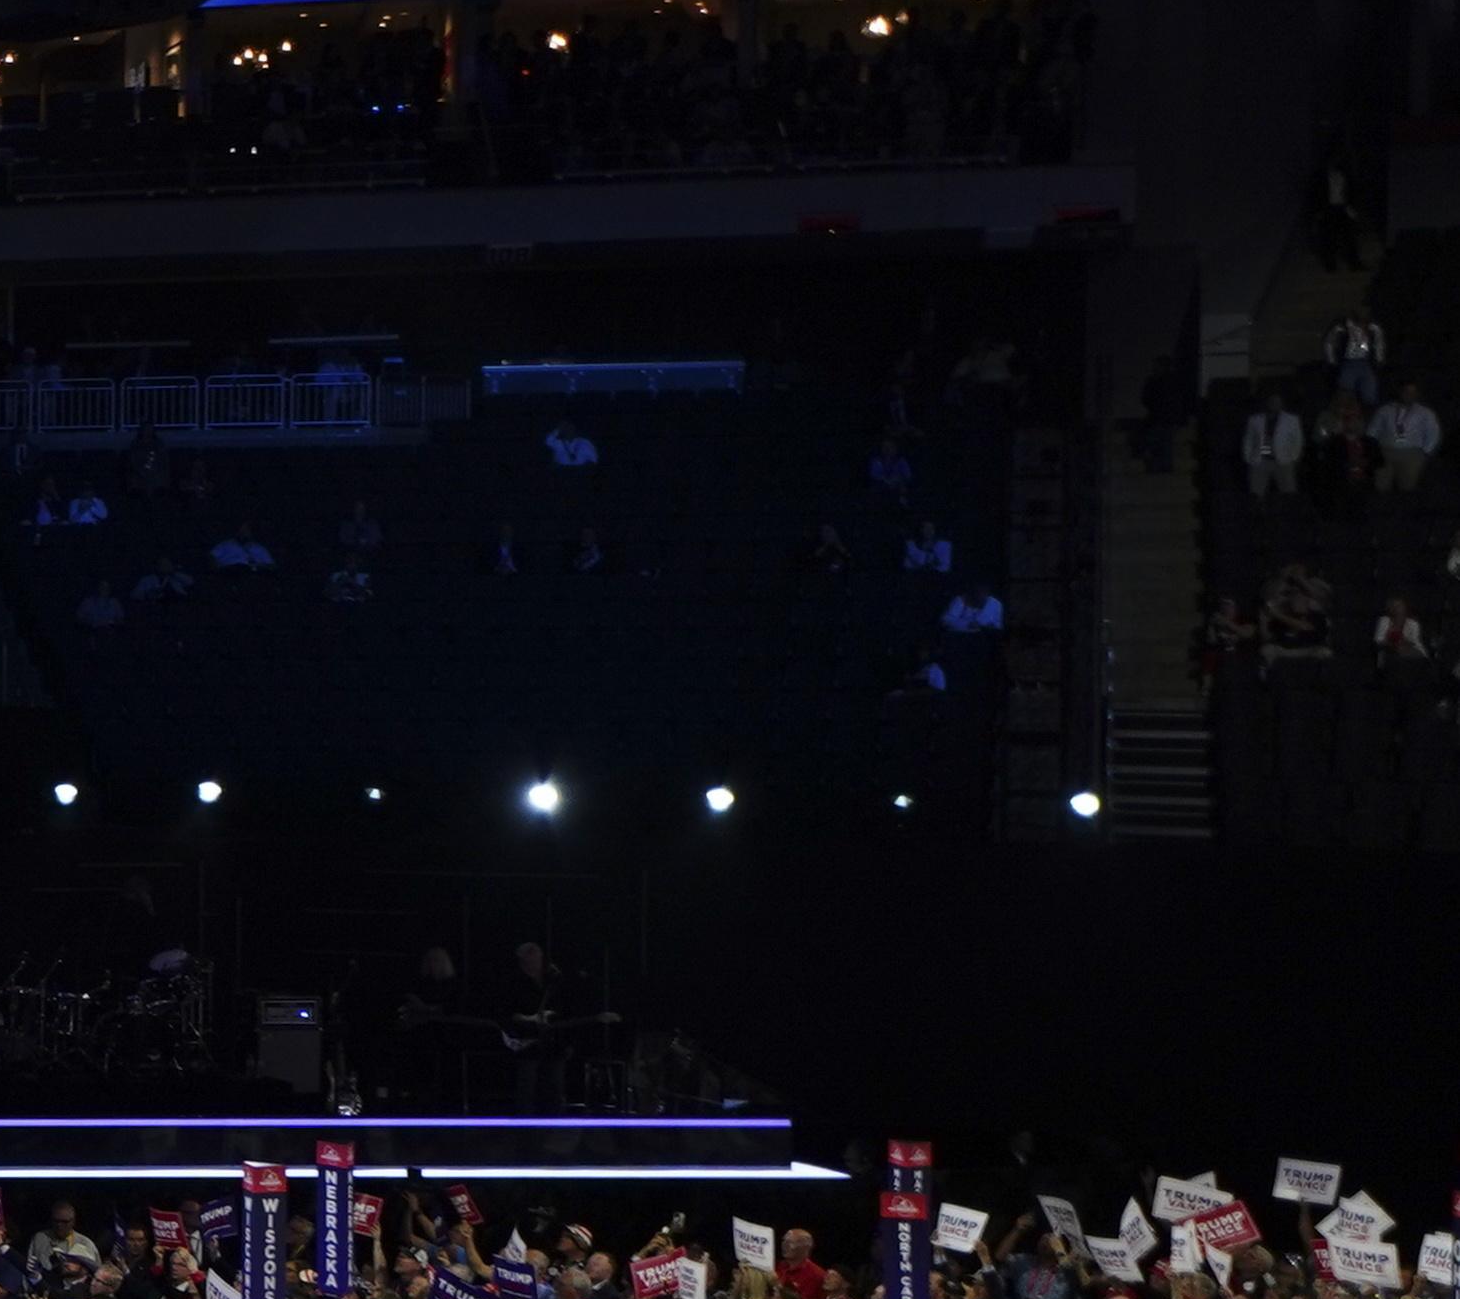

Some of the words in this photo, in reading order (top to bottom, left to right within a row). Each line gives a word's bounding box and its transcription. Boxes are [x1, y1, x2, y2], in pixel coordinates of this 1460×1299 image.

[1283, 1167, 1334, 1184] TRUMP
[1287, 1178, 1327, 1191] VANCE
[1164, 1189, 1223, 1209] TRUMP
[200, 1205, 233, 1224] TRUMP
[939, 1213, 978, 1230] TRUMP
[325, 1169, 339, 1289] NEBRASKA
[734, 1228, 769, 1245] TRUMP
[898, 1222, 913, 1272] NORTH
[1334, 1246, 1390, 1263] TRUMP
[1339, 1257, 1384, 1273] VANCE
[498, 1266, 534, 1285] TRUMP
